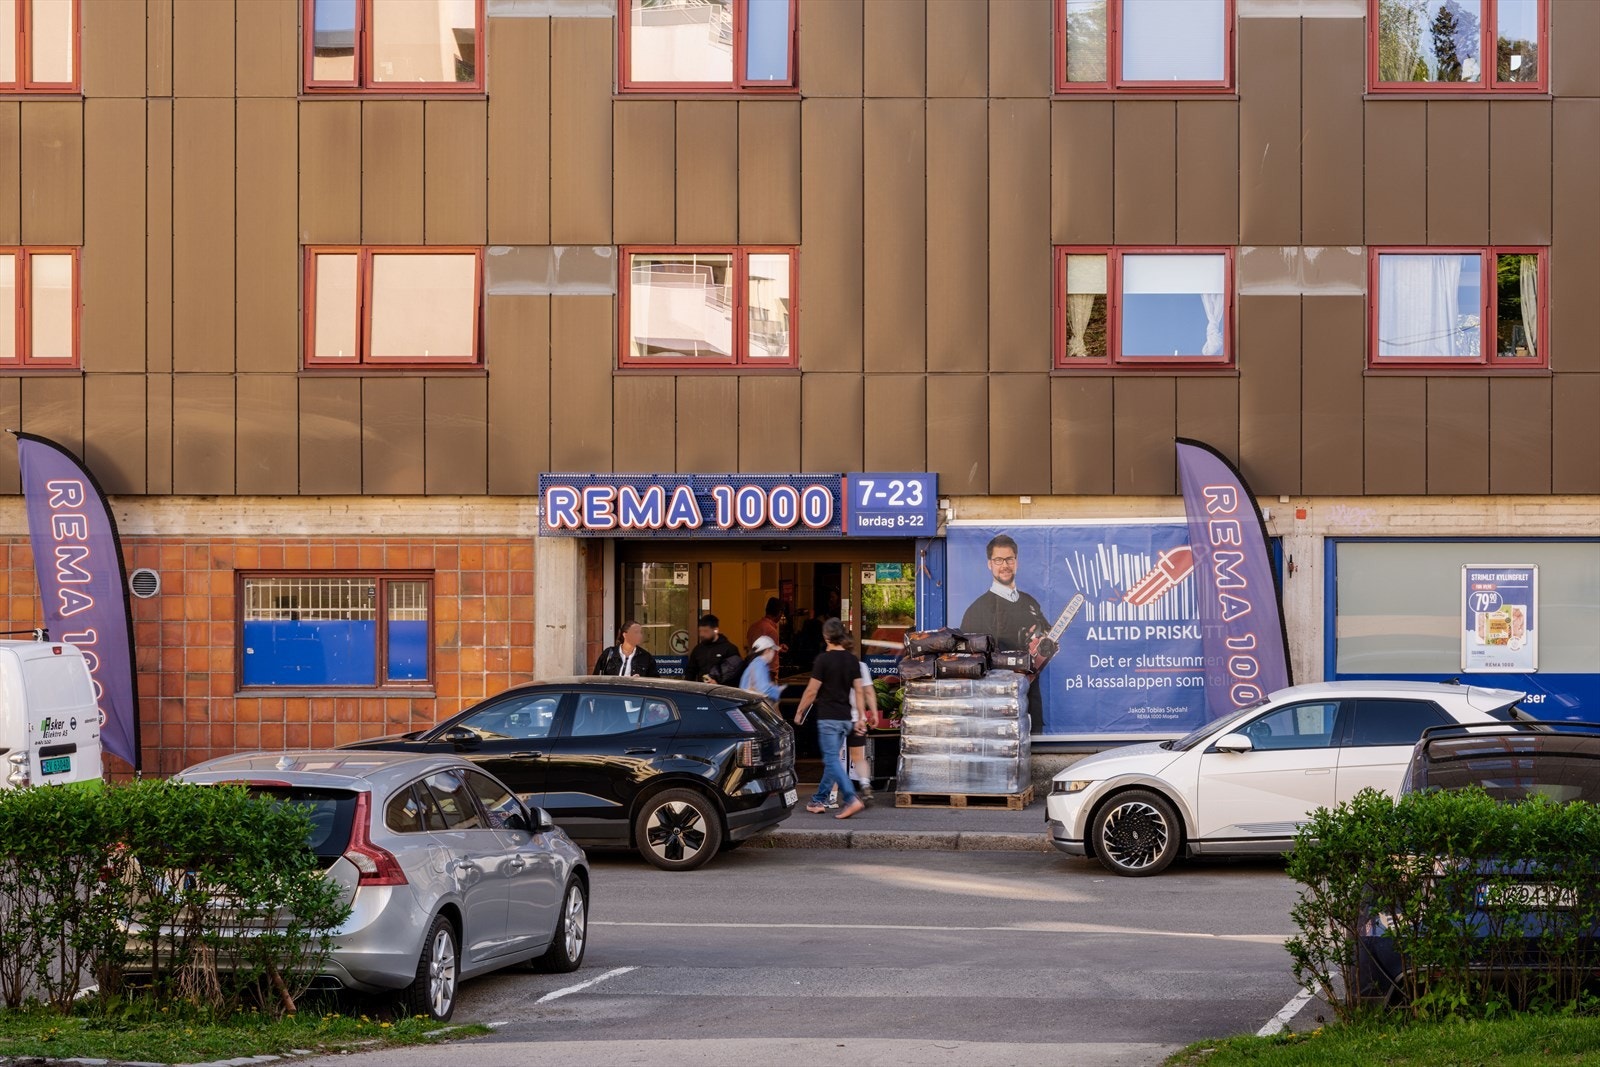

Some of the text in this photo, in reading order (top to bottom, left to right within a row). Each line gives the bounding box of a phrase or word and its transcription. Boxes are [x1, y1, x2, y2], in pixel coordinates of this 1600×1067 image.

[859, 480, 923, 506] 7-23
[545, 485, 835, 530] REMA 1000
[859, 515, 924, 528] lørdag 8-22
[47, 480, 93, 617] REMA
[1203, 485, 1263, 707] REMA 100
[1475, 593, 1490, 611] 79
[1050, 614, 1069, 639] REMA
[1086, 625, 1141, 641] ALLTID
[1090, 655, 1115, 668] Det
[1118, 656, 1132, 668] er
[1066, 675, 1083, 691] på
[1087, 674, 1172, 690] kassalappen
[1176, 677, 1204, 688] som
[1128, 706, 1146, 714] Jakob
[43, 717, 65, 732] Asker
